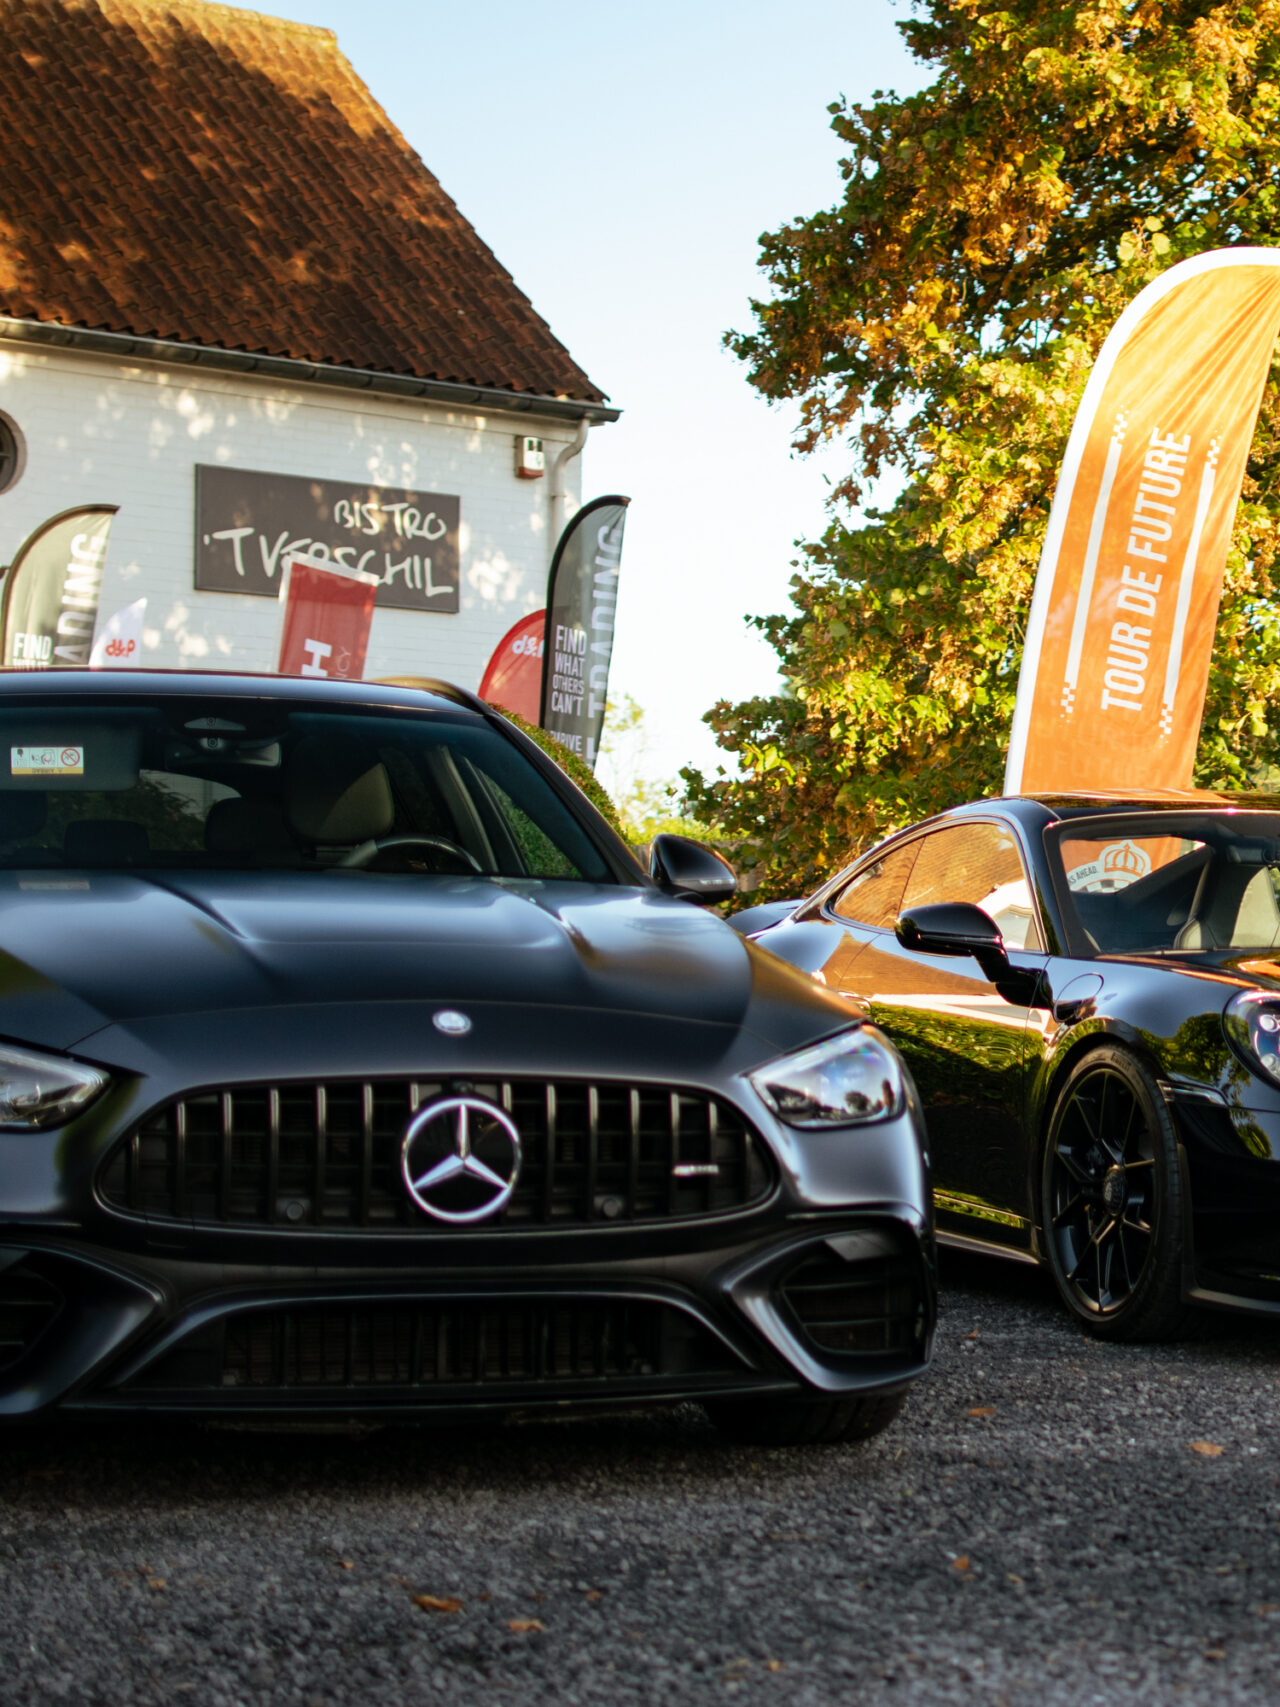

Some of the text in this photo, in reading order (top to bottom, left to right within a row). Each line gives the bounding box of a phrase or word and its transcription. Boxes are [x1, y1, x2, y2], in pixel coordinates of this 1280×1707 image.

[334, 500, 447, 540] BISTRO
[1101, 427, 1191, 711] TOUR DE FUTURE
[13, 632, 52, 660] FIND
[555, 625, 587, 655] FIND
[554, 652, 584, 678] WHAT
[552, 674, 584, 695] OTHERS
[551, 691, 584, 717] CAN'T
[550, 730, 582, 751] RIVE
